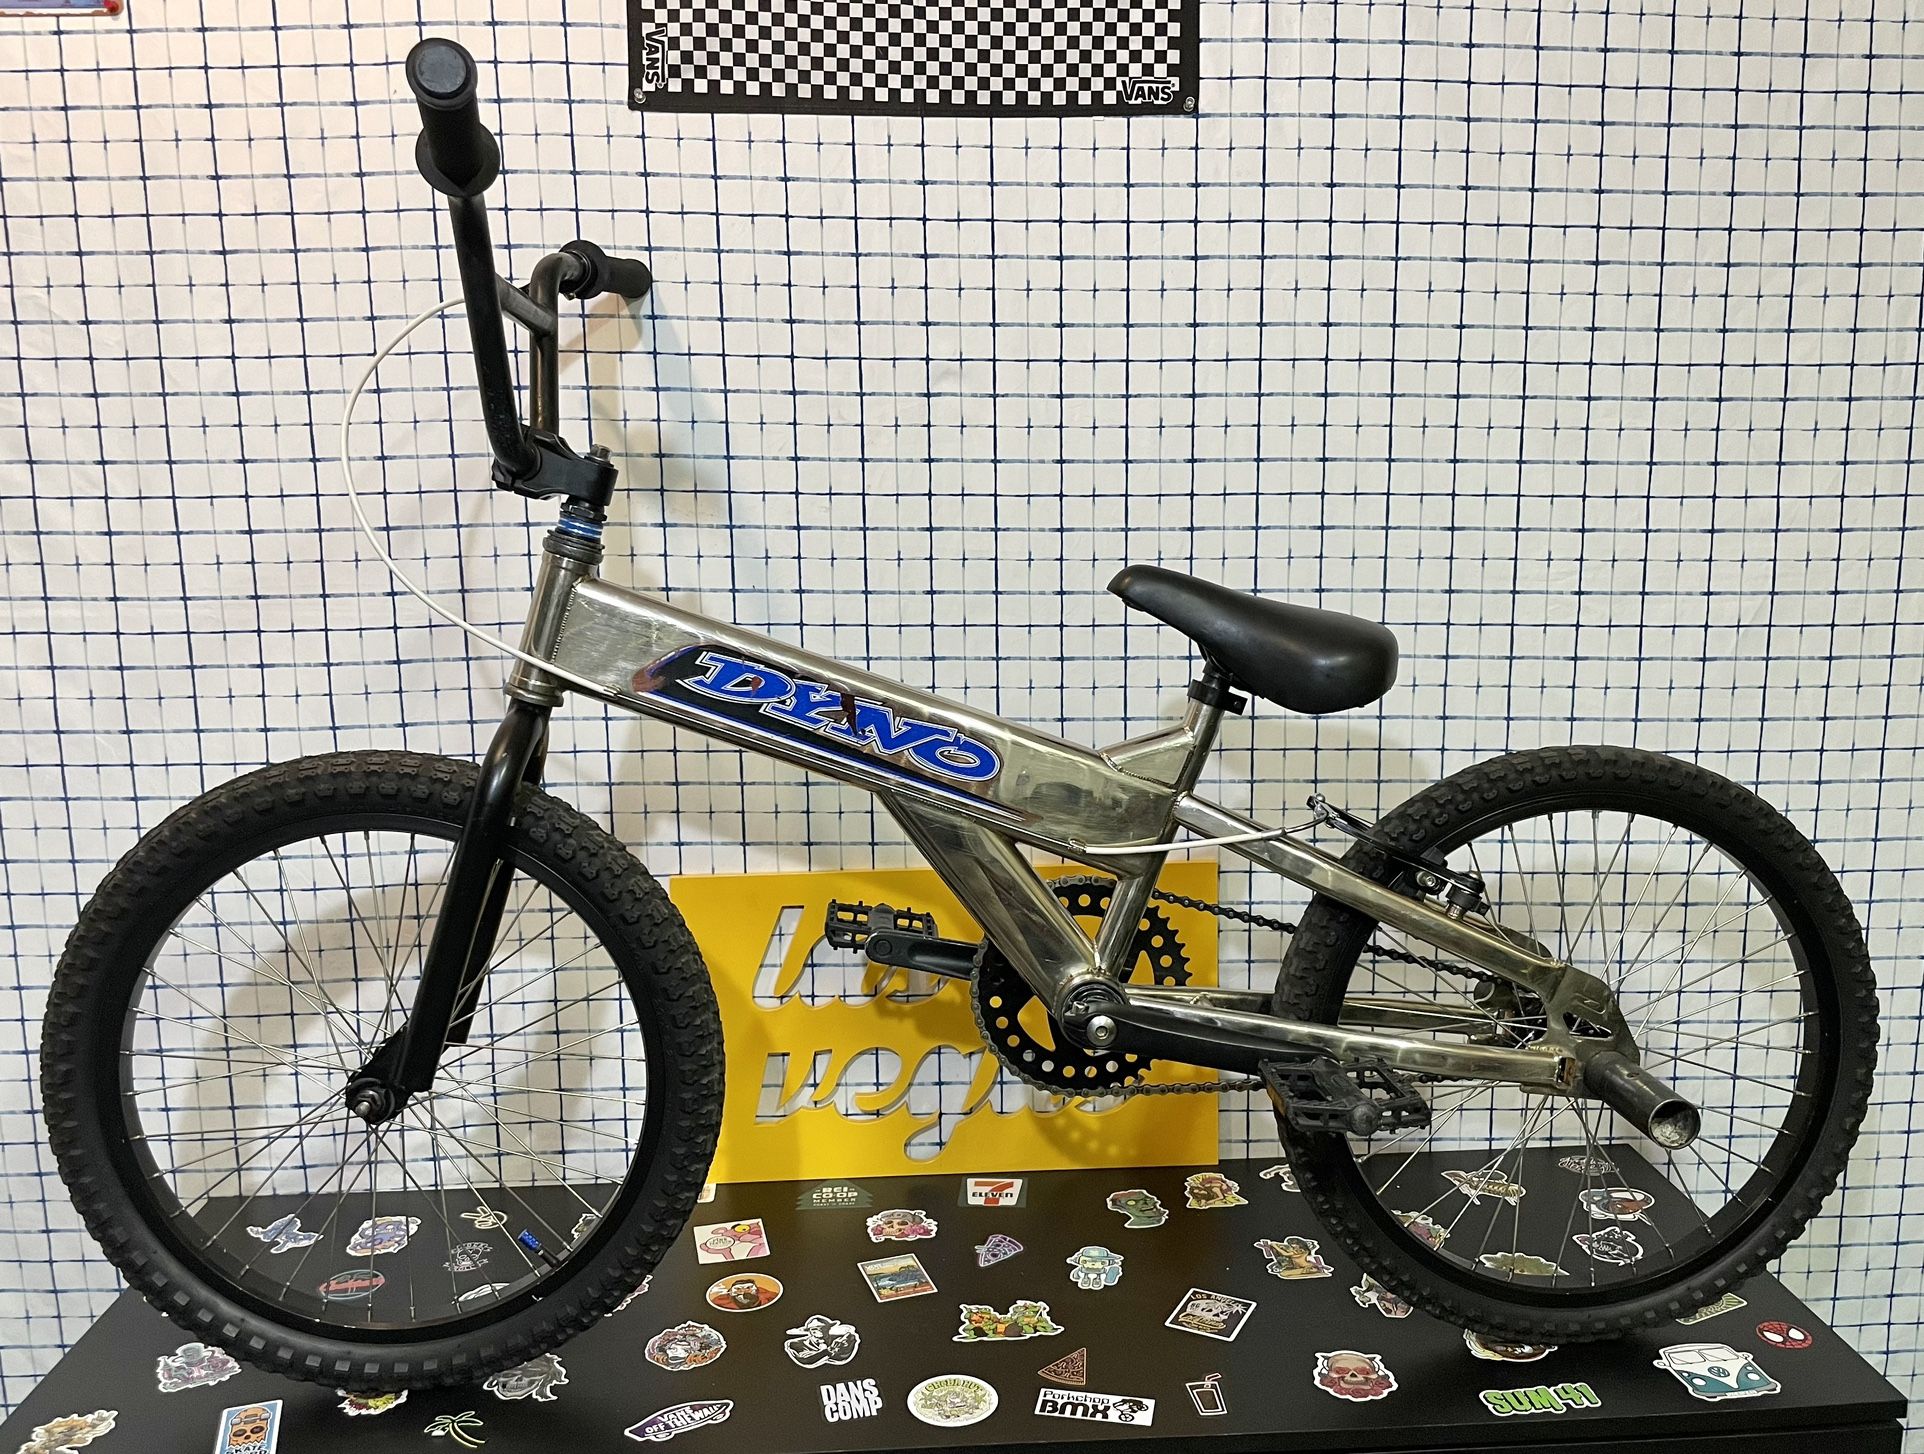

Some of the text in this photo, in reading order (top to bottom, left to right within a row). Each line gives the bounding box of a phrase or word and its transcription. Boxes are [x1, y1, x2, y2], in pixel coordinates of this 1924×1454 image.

[645, 27, 667, 86] VANS
[1121, 79, 1173, 102] VANS
[676, 651, 1002, 782] DYNO
[820, 1378, 880, 1406] DANS
[1042, 1390, 1110, 1406] Porkchop
[1485, 1384, 1599, 1414] SUM 41
[645, 1404, 725, 1434] OFF THE WALL
[658, 1406, 692, 1422] VANS
[824, 1393, 883, 1422] COMP
[1038, 1399, 1111, 1420] BMX
